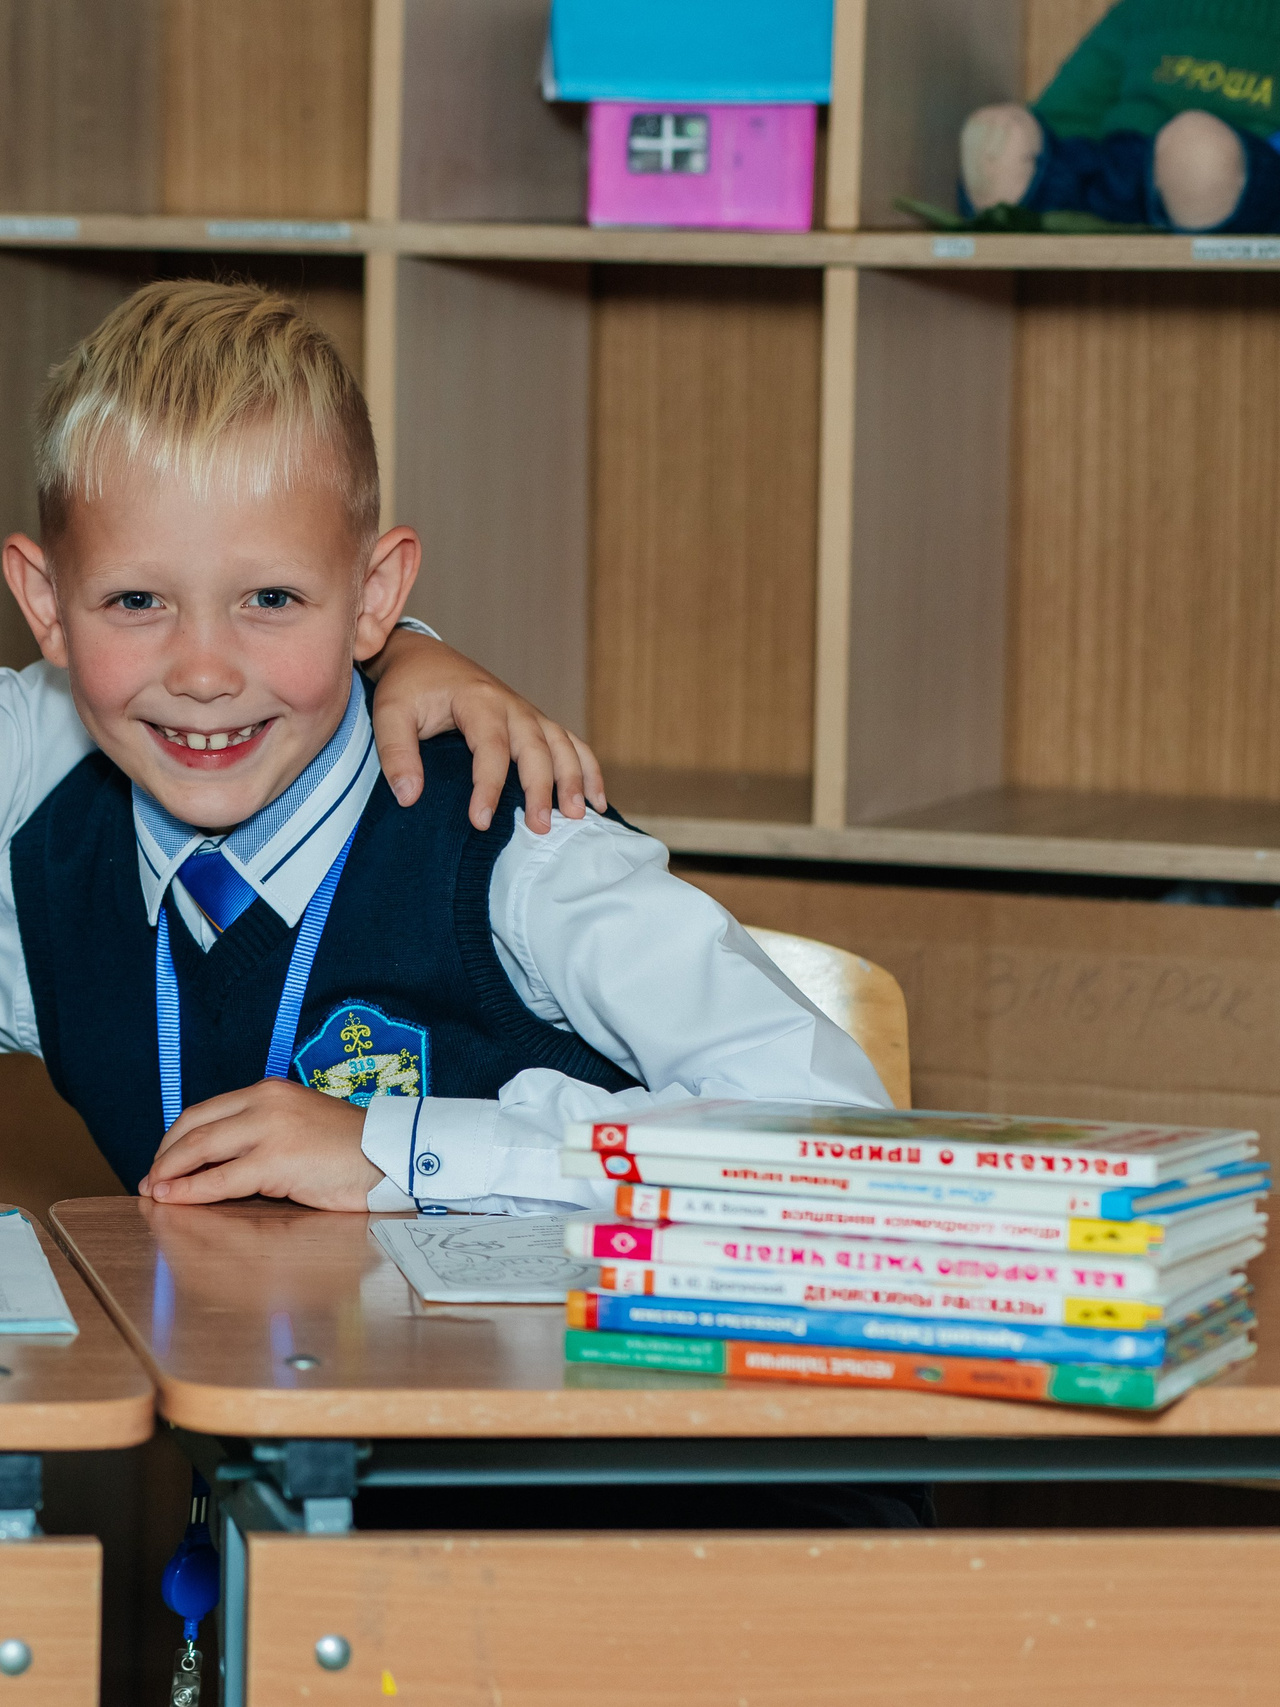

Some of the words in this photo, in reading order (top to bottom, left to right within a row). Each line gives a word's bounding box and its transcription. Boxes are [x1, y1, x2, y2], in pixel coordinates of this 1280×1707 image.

[348, 1057, 376, 1075] 319
[799, 1140, 921, 1164] ПРИРОДЕ
[836, 1251, 924, 1274] УМЕТЬ
[937, 1257, 1058, 1283] ХОРОШО
